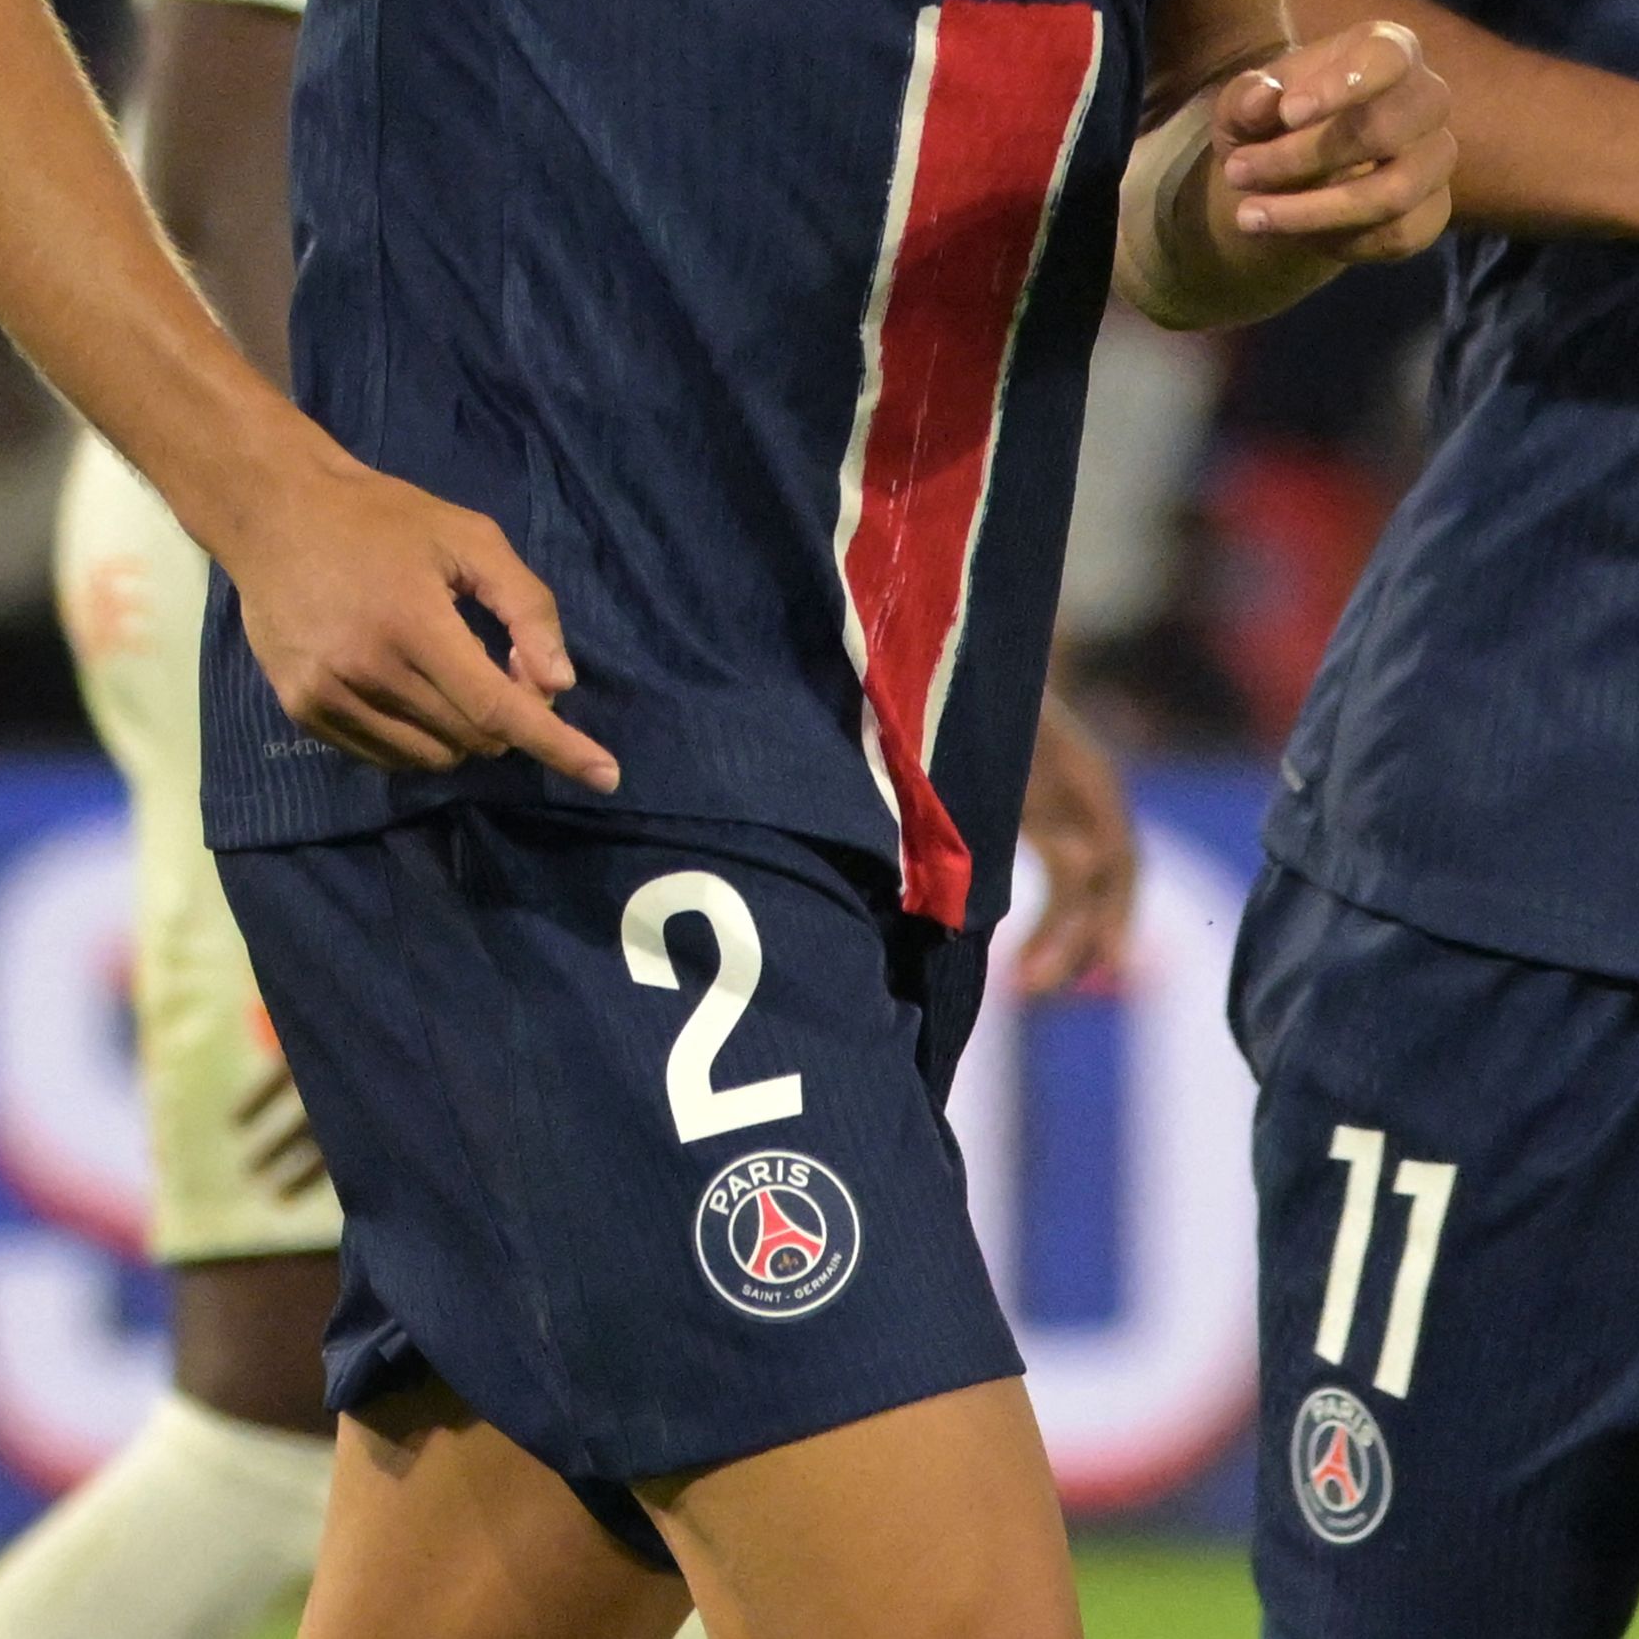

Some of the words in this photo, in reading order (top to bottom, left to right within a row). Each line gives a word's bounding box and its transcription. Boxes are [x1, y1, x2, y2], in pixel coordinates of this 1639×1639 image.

[621, 870, 803, 1144] 2
[709, 1159, 811, 1216] PARIS
[1314, 1124, 1459, 1400] 11
[742, 1284, 781, 1303] SAINT
[794, 1252, 843, 1299] GERMAIN
